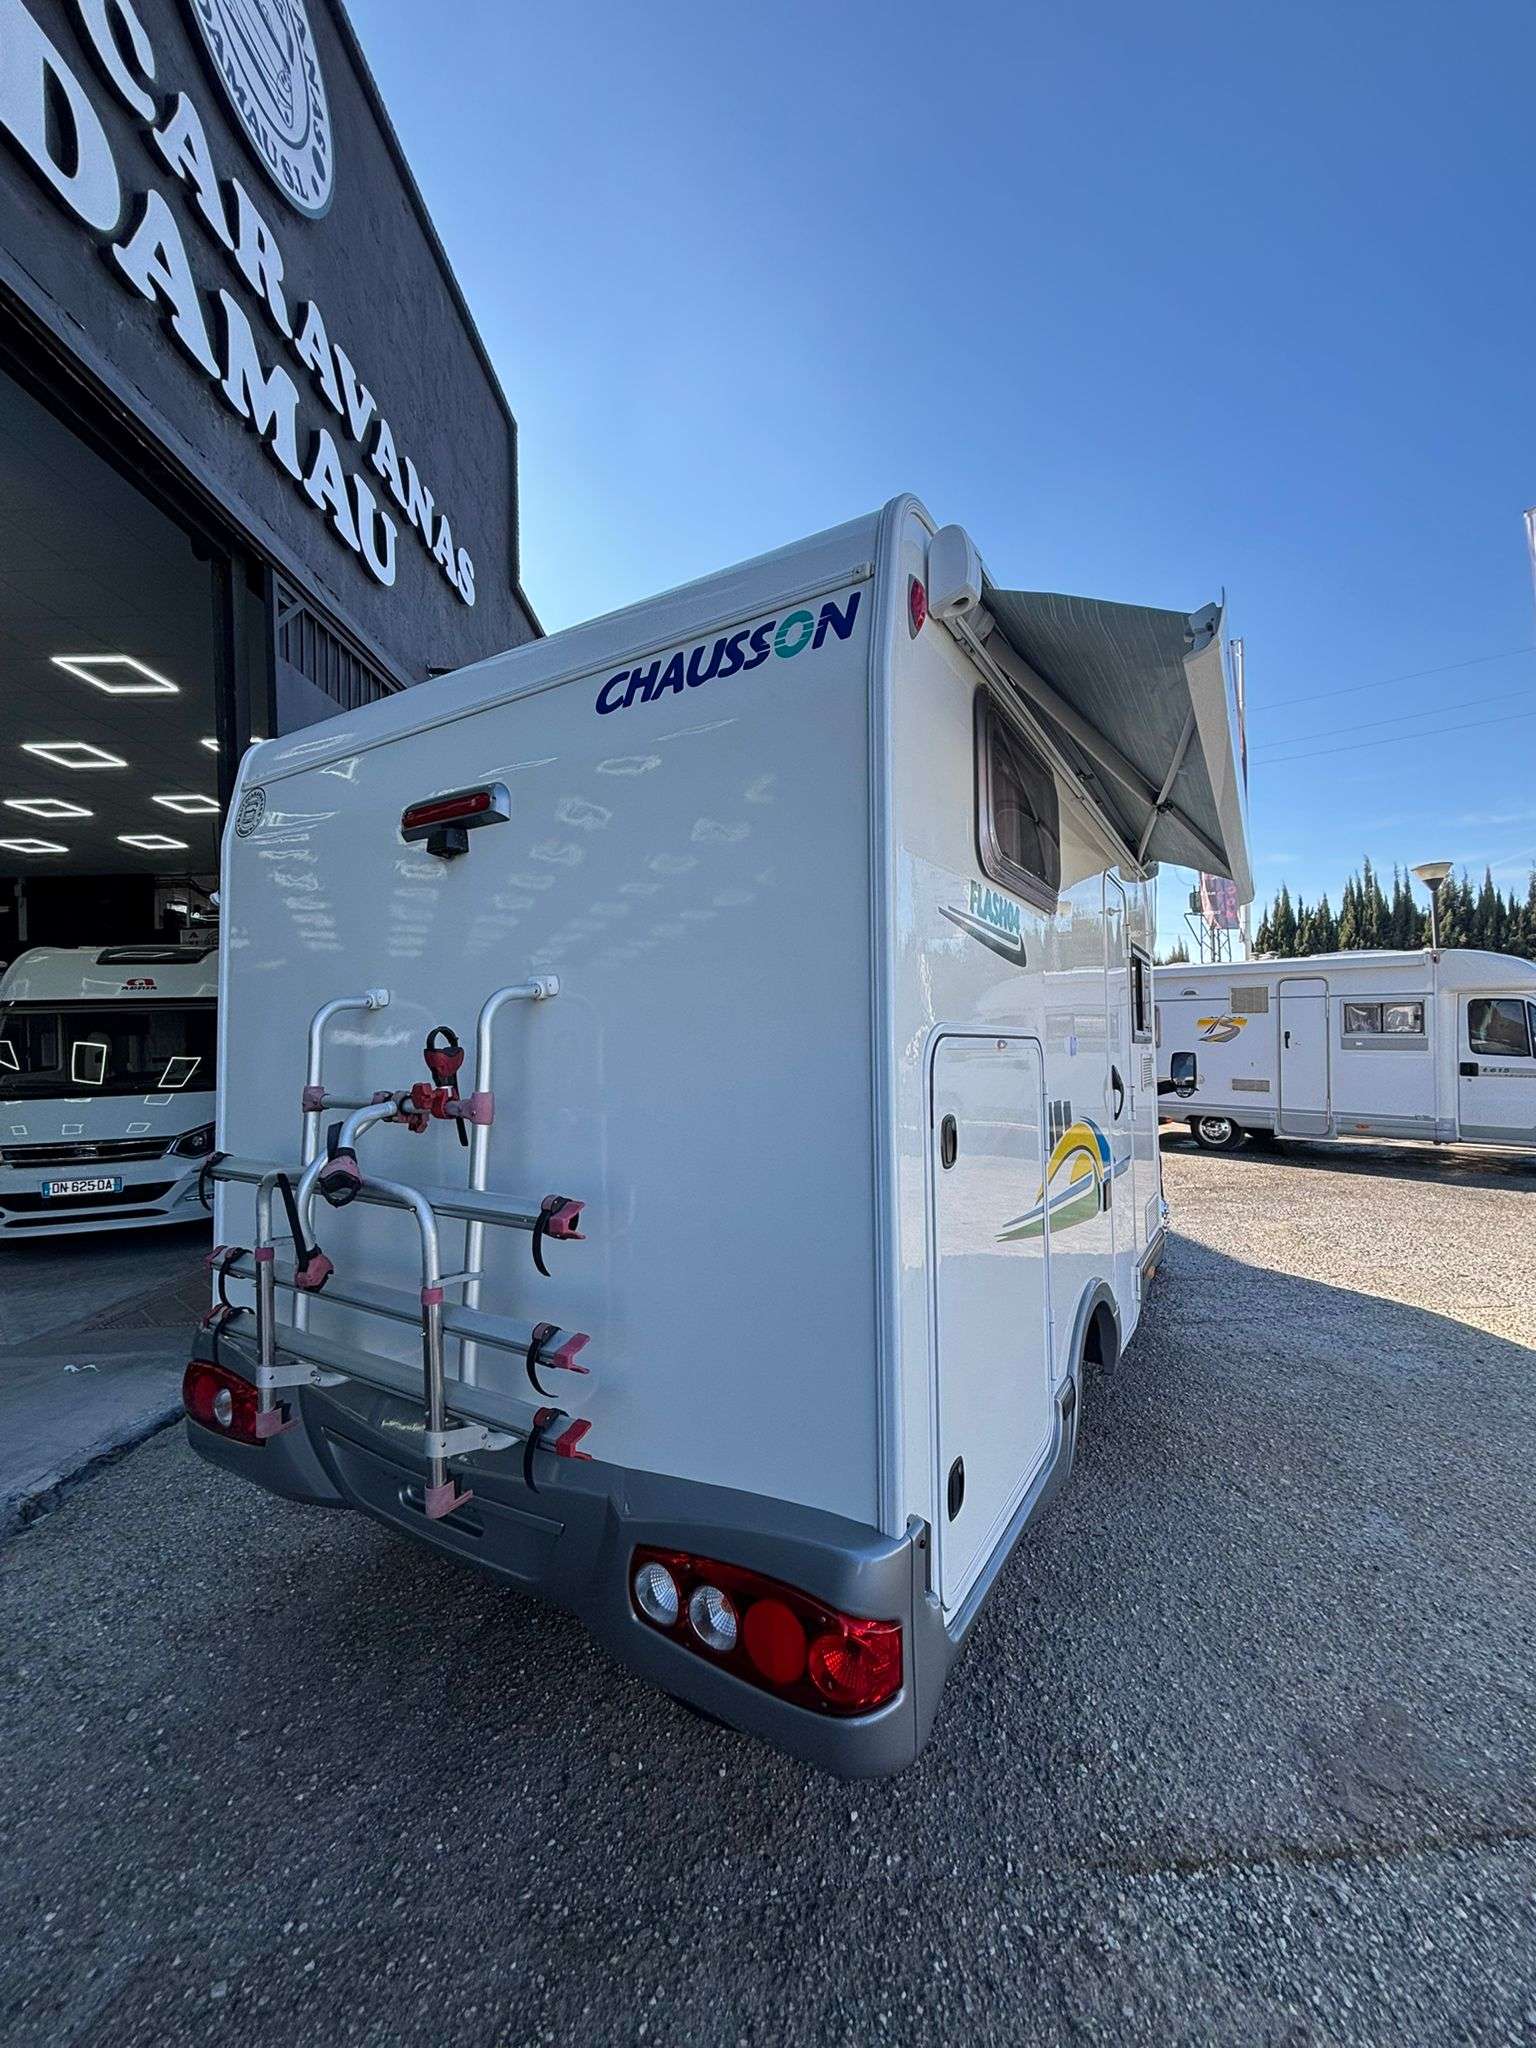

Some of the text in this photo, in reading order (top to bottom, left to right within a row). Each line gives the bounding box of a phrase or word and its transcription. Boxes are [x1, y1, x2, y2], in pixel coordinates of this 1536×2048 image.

[0, 0, 397, 587] DAMAU
[78, 0, 474, 607] CARAVANAS
[595, 591, 861, 715] CHAUSSON
